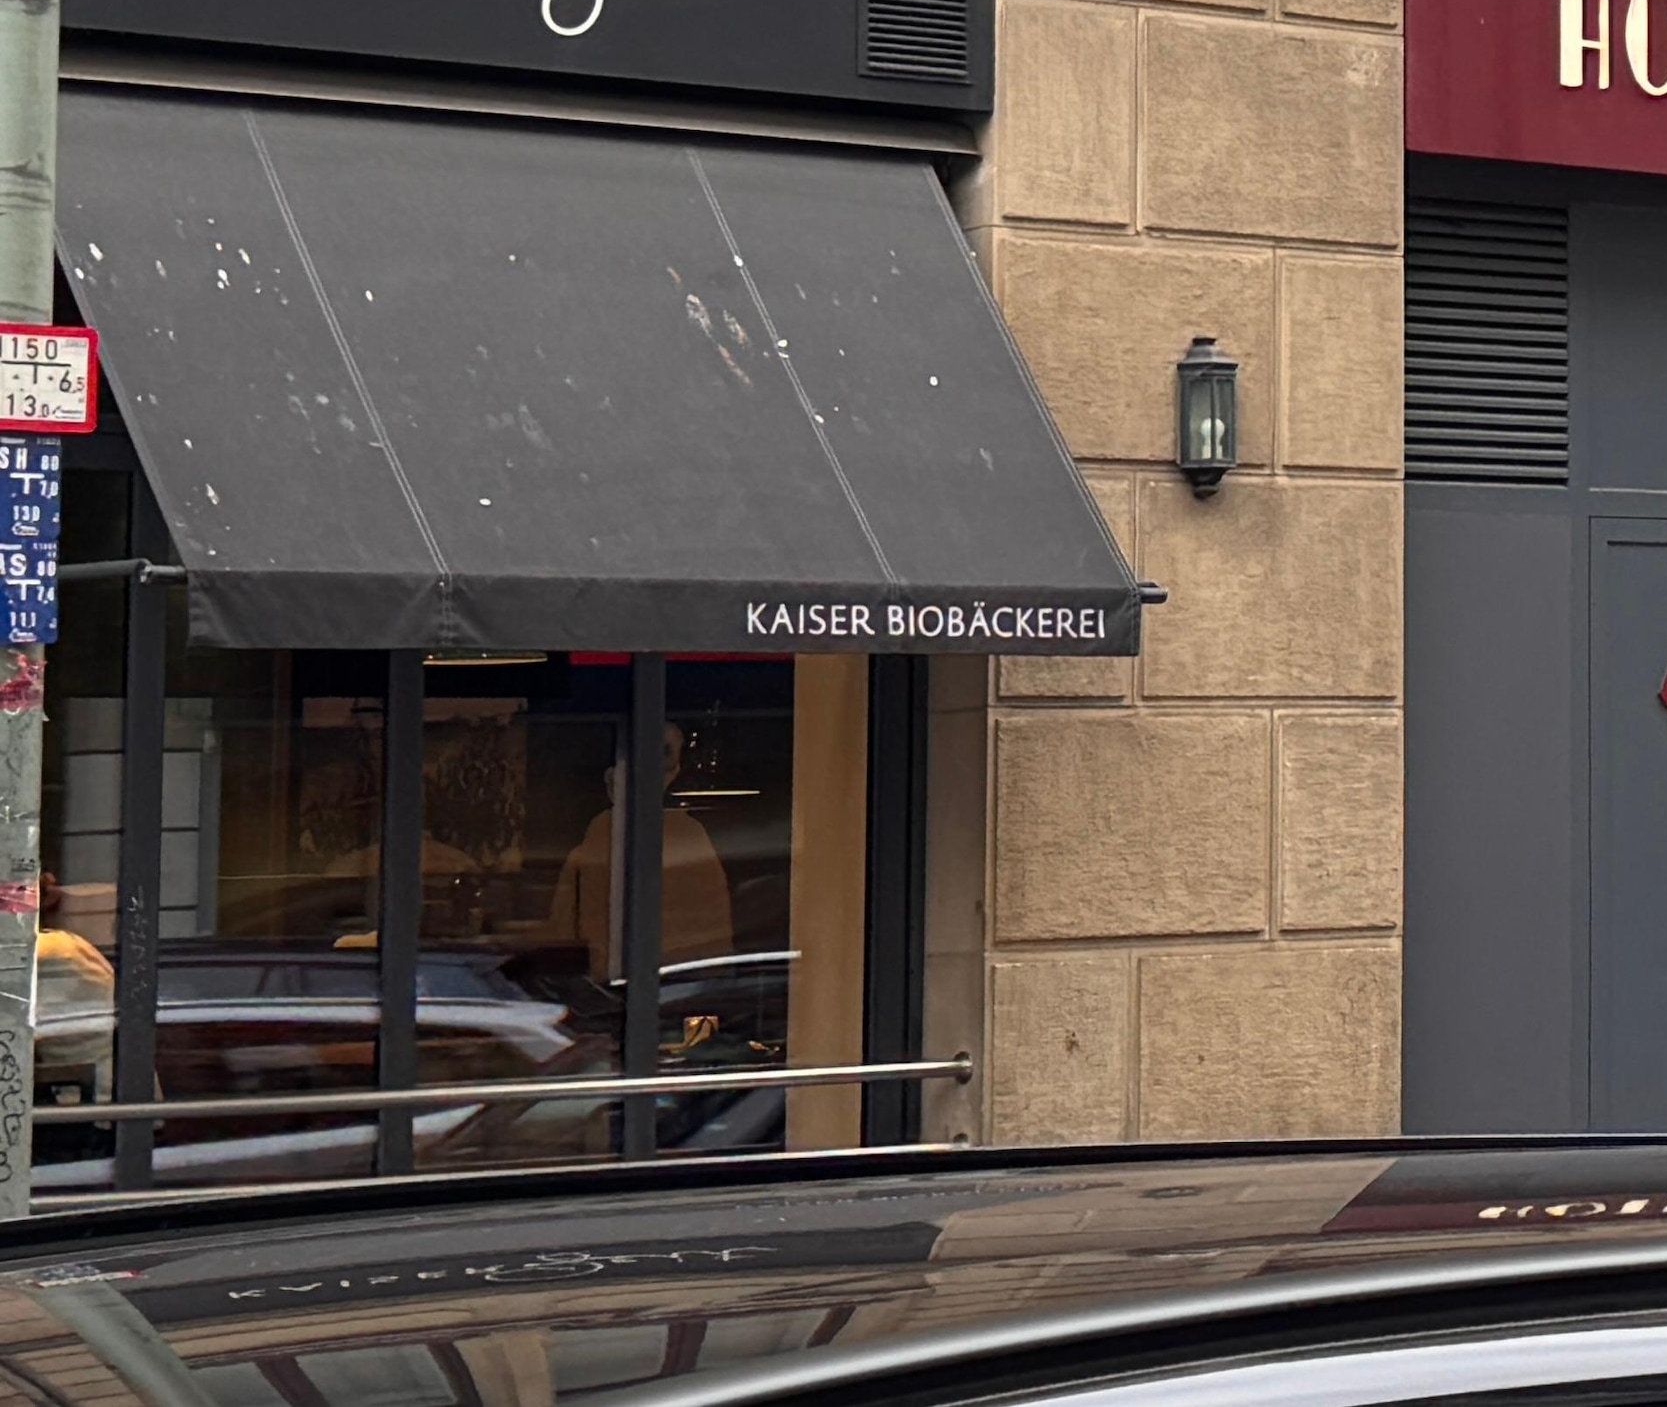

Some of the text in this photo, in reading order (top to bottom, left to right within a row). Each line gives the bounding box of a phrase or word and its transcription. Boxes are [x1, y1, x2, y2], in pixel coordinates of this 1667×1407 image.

[0, 336, 58, 360] 150
[746, 600, 1106, 639] KAISER BIOBÄCKEREI
